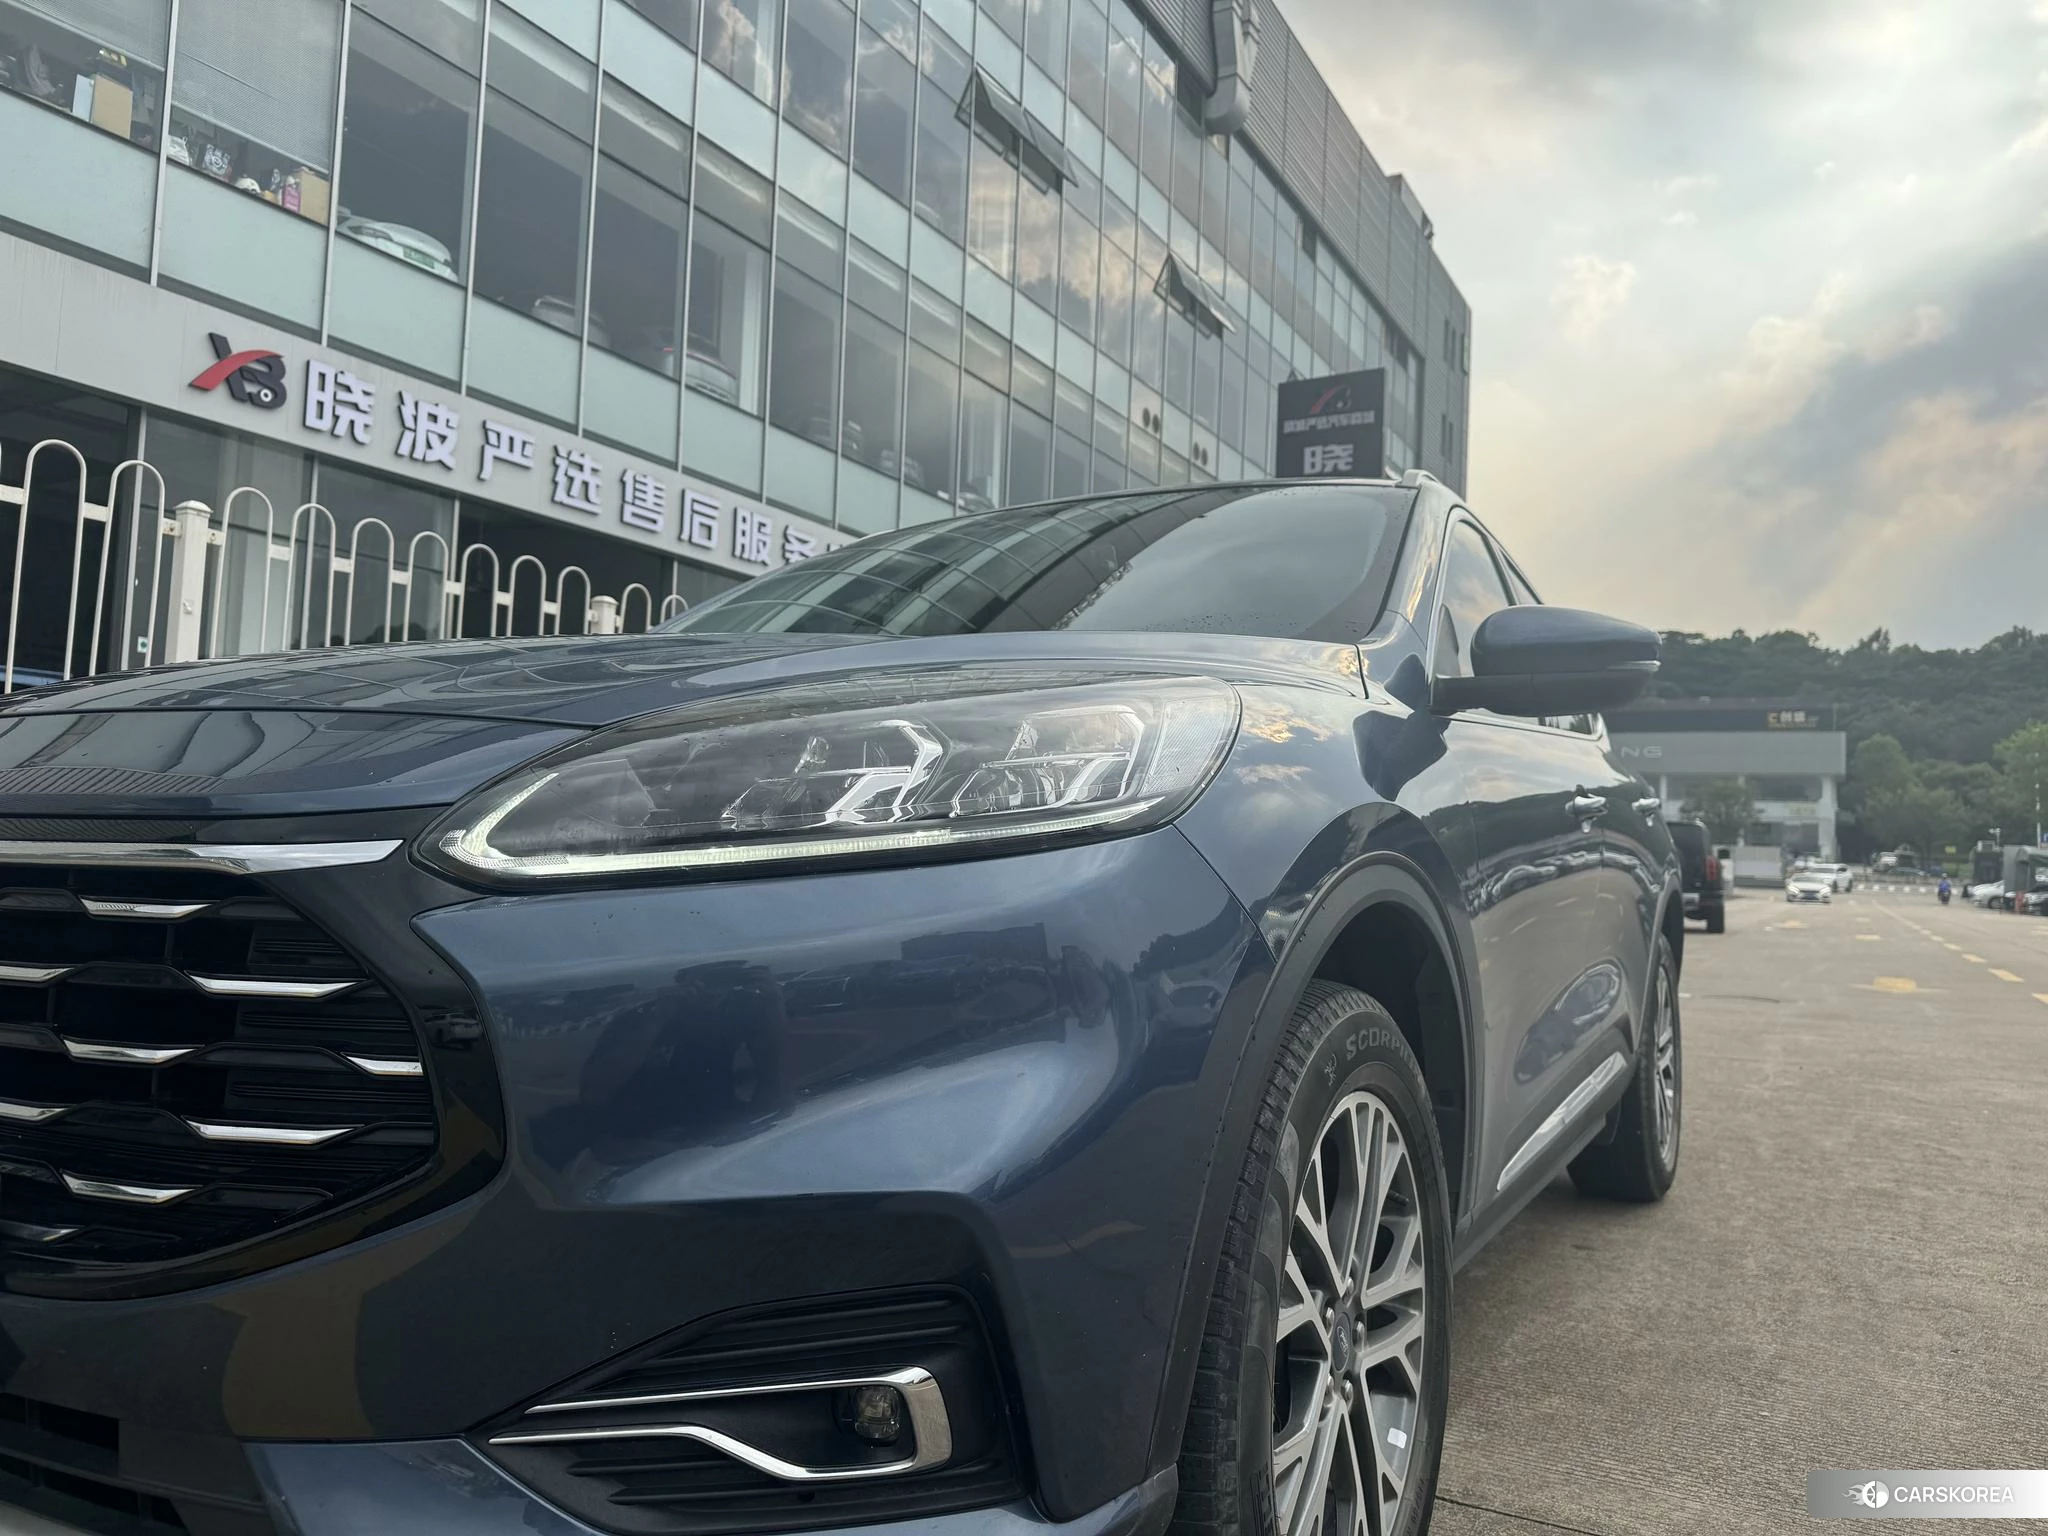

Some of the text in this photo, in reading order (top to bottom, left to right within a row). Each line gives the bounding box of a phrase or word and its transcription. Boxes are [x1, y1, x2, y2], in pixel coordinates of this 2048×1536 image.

[304, 359, 844, 564] 晓波严选售后服务
[1346, 1027, 1418, 1070] SCORPI
